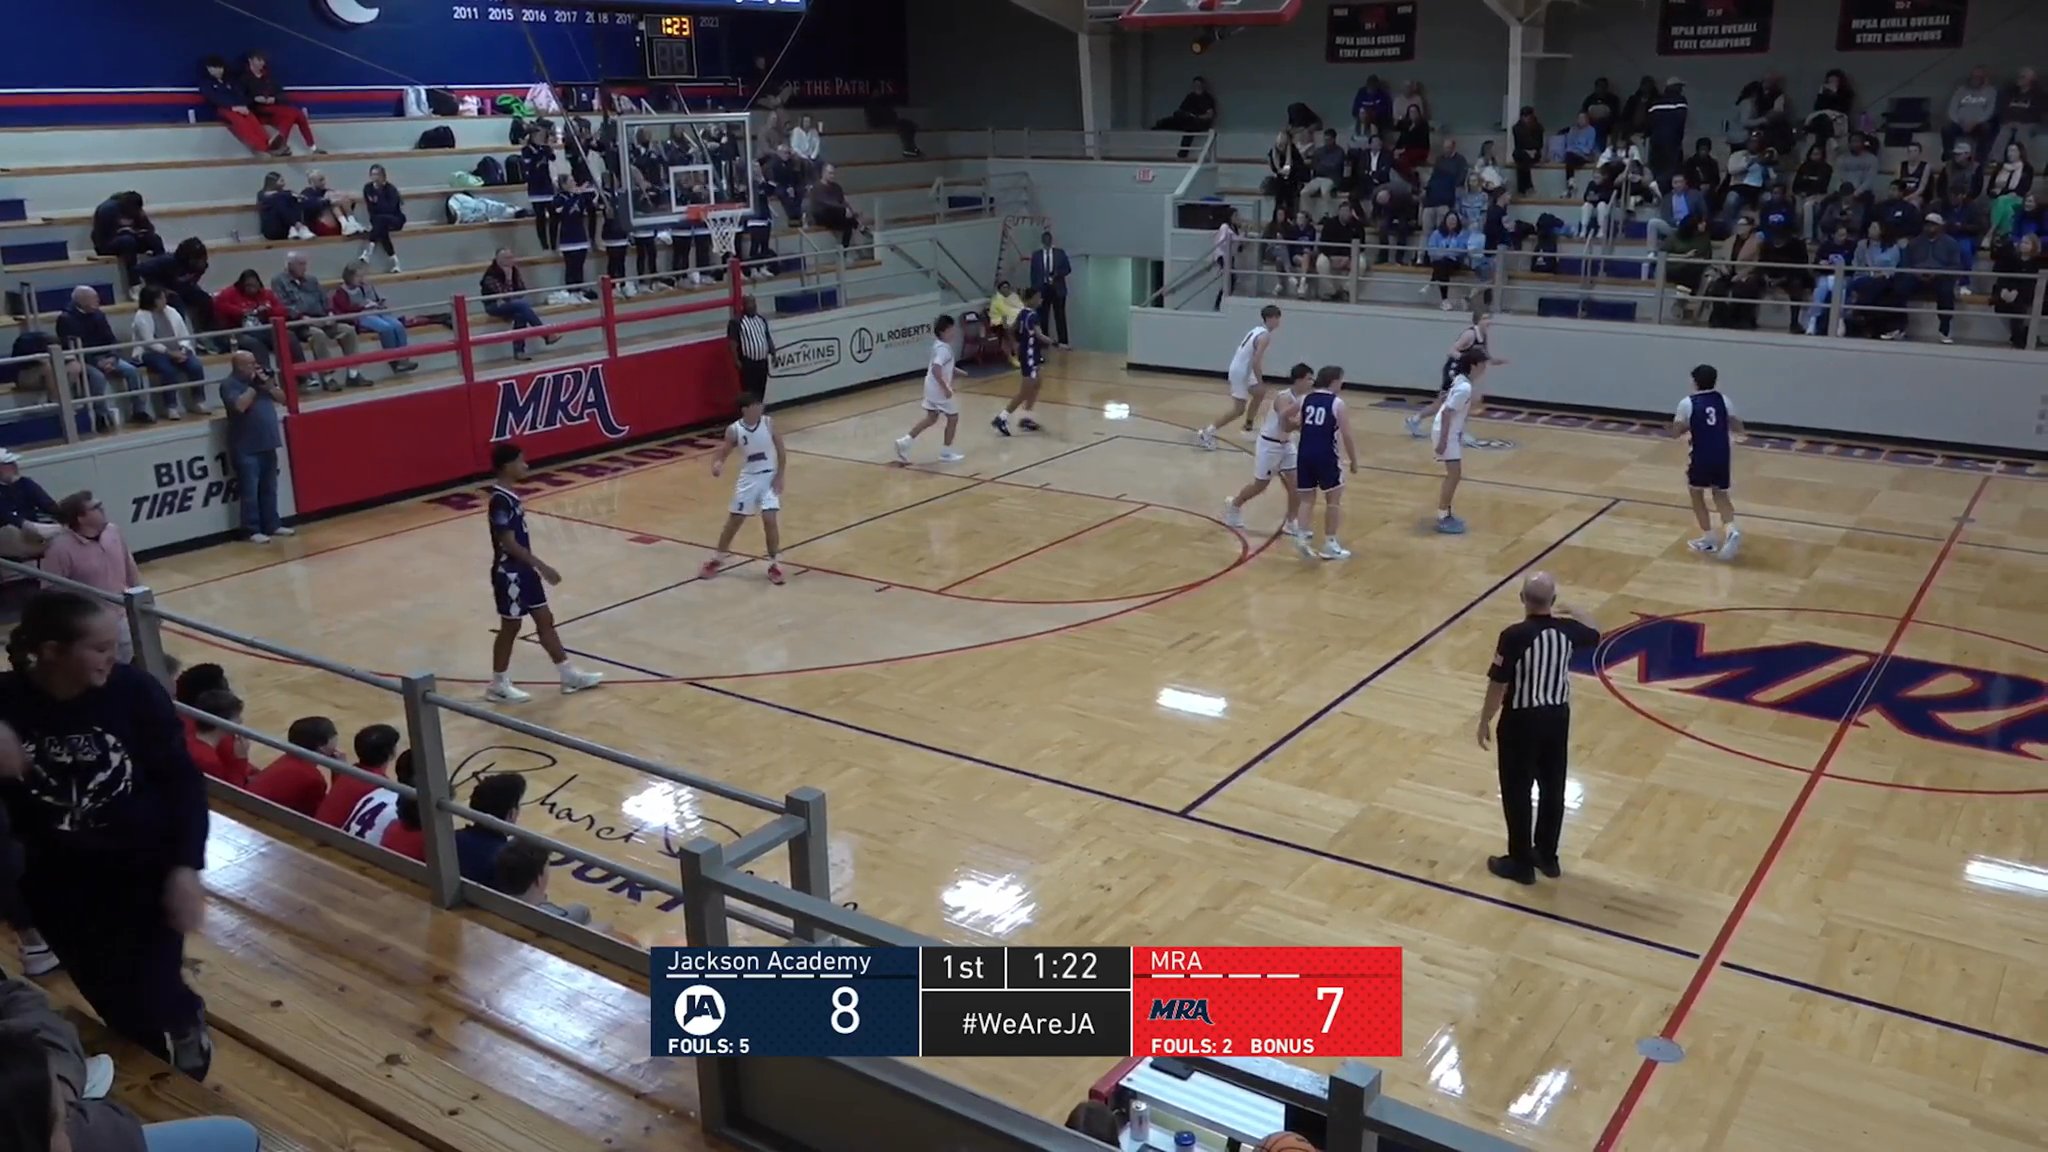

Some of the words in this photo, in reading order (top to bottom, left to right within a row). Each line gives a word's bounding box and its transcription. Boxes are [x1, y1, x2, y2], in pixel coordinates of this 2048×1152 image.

[453, 7, 479, 19] 2011
[488, 8, 514, 21] 2015
[522, 9, 547, 22] 2016
[554, 11, 577, 23] 2017
[661, 17, 690, 36] 1:23
[806, 81, 832, 95] THE
[835, 77, 893, 95] PATRITS
[887, 323, 931, 340] ROBERTS
[773, 344, 836, 368] WATKINS
[489, 363, 629, 442] MRA
[1305, 405, 1326, 426] 20
[1705, 406, 1717, 426] 3
[154, 456, 208, 488] BIG
[131, 487, 196, 523] TIRE
